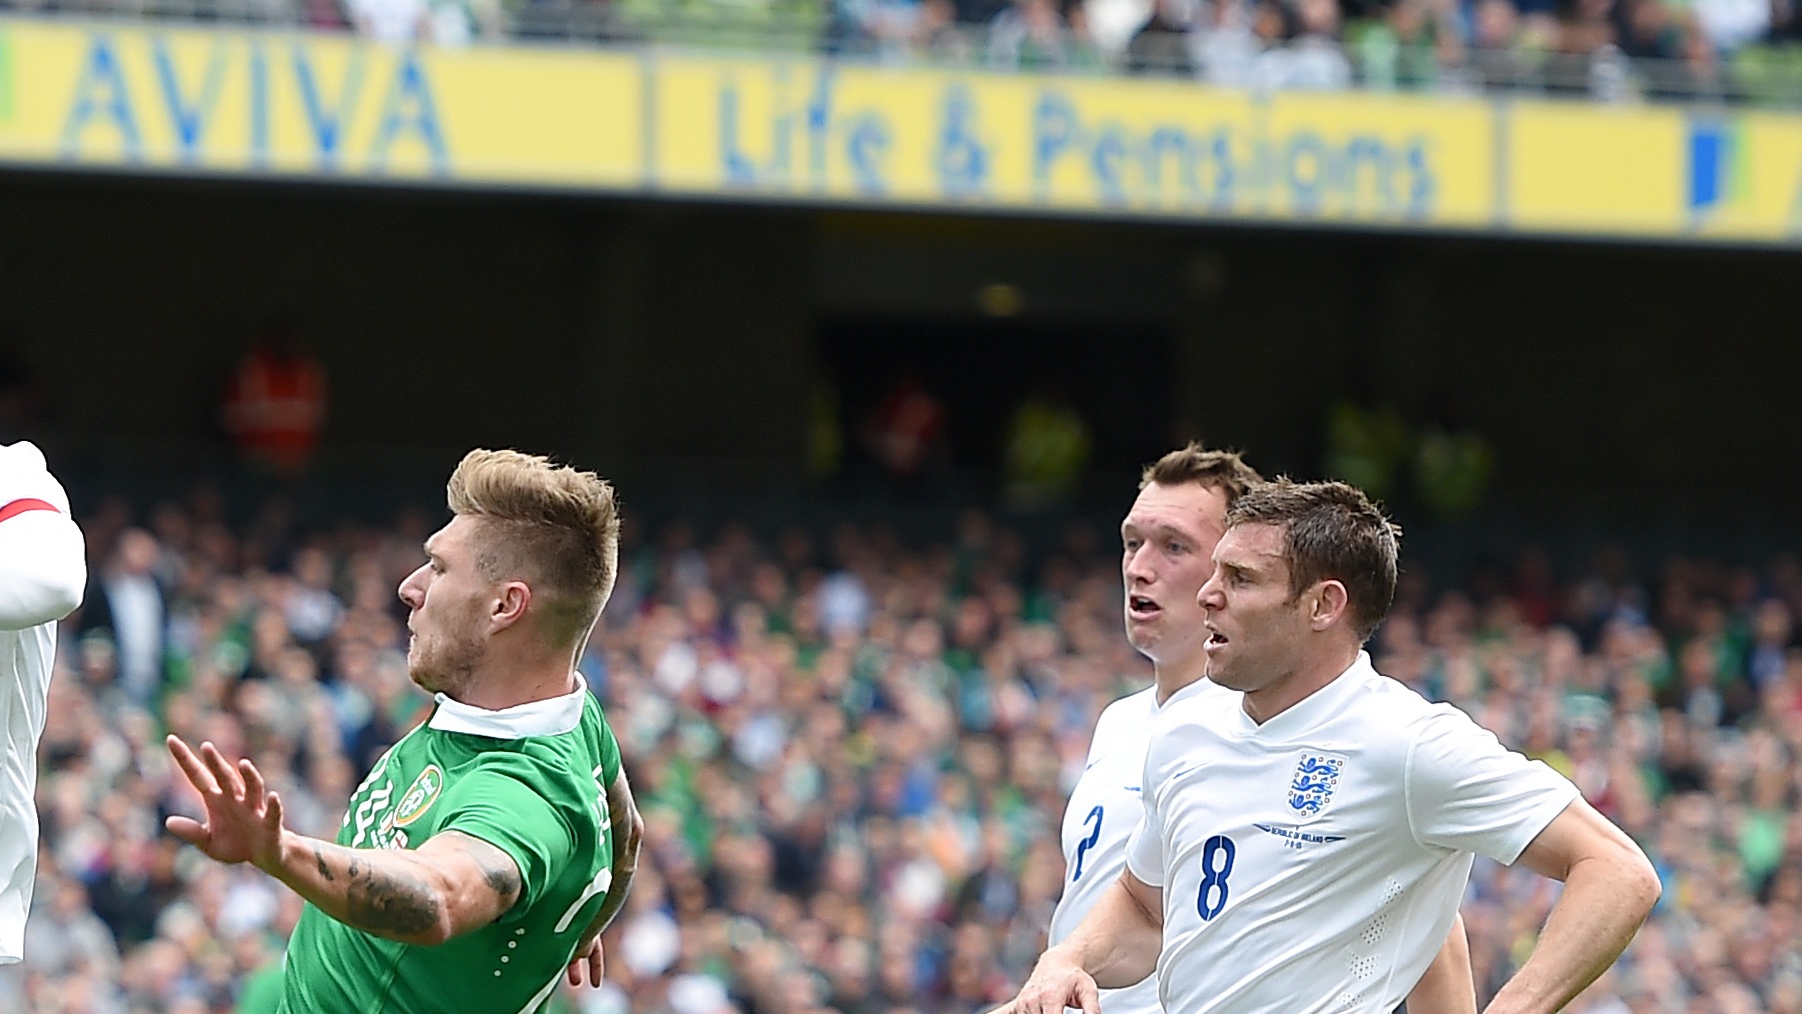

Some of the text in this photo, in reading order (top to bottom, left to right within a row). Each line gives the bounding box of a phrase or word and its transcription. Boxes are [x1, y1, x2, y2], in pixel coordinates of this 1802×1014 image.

[60, 32, 454, 176] AVIVA
[718, 62, 1434, 218] Life & Pensions
[1197, 835, 1236, 921] 8
